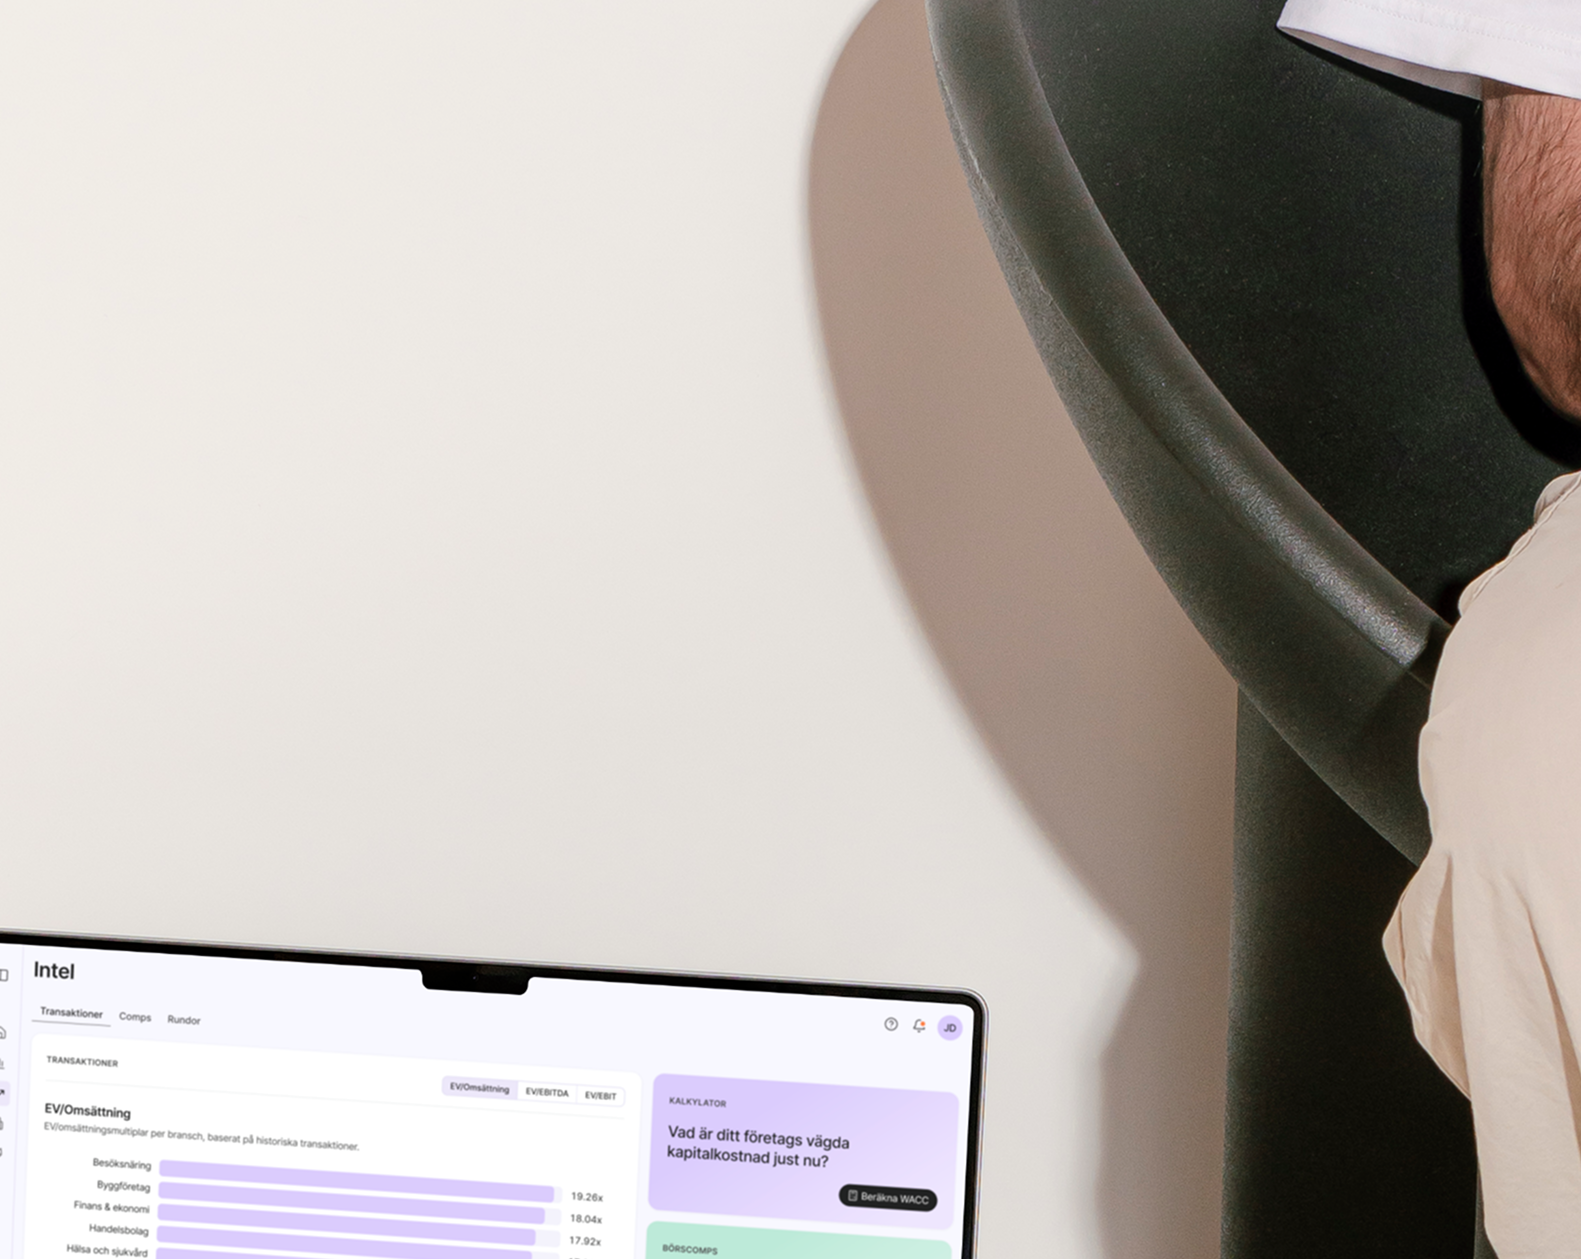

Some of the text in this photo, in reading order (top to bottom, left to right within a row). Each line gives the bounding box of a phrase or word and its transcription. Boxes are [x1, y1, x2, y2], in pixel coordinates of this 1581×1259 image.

[34, 961, 75, 980] Intel
[40, 1006, 201, 1025] Transaktioner Comps Rundor
[944, 1023, 957, 1033] JD
[47, 1055, 118, 1067] TRANSAKTIONER
[450, 1082, 617, 1100] EV/Omsättning EV/EBITDA EV/EBIT
[669, 1097, 727, 1108] KALKYLATOR
[45, 1103, 131, 1121] EV/Omsättning
[44, 1121, 359, 1151] EV/omsättningsmultiplar per bransch, baserat på historiska transaktioner.
[668, 1125, 850, 1151] Vad är ditt företags vägda
[667, 1145, 829, 1168] kapitalkostnad just nu?
[93, 1157, 152, 1172] Besöksnäring
[97, 1180, 151, 1194] Byggföretag
[572, 1192, 603, 1202] 19.26x
[861, 1191, 929, 1205] Beräkna WACC
[74, 1200, 150, 1214] Finans & ekonomi
[571, 1214, 602, 1224] 18.04x
[89, 1224, 149, 1238] Handelsbolag
[570, 1236, 601, 1246] 17.92x
[66, 1244, 148, 1258] Hälsa och sjukvård
[662, 1243, 718, 1256] BÖRSCOMPS
